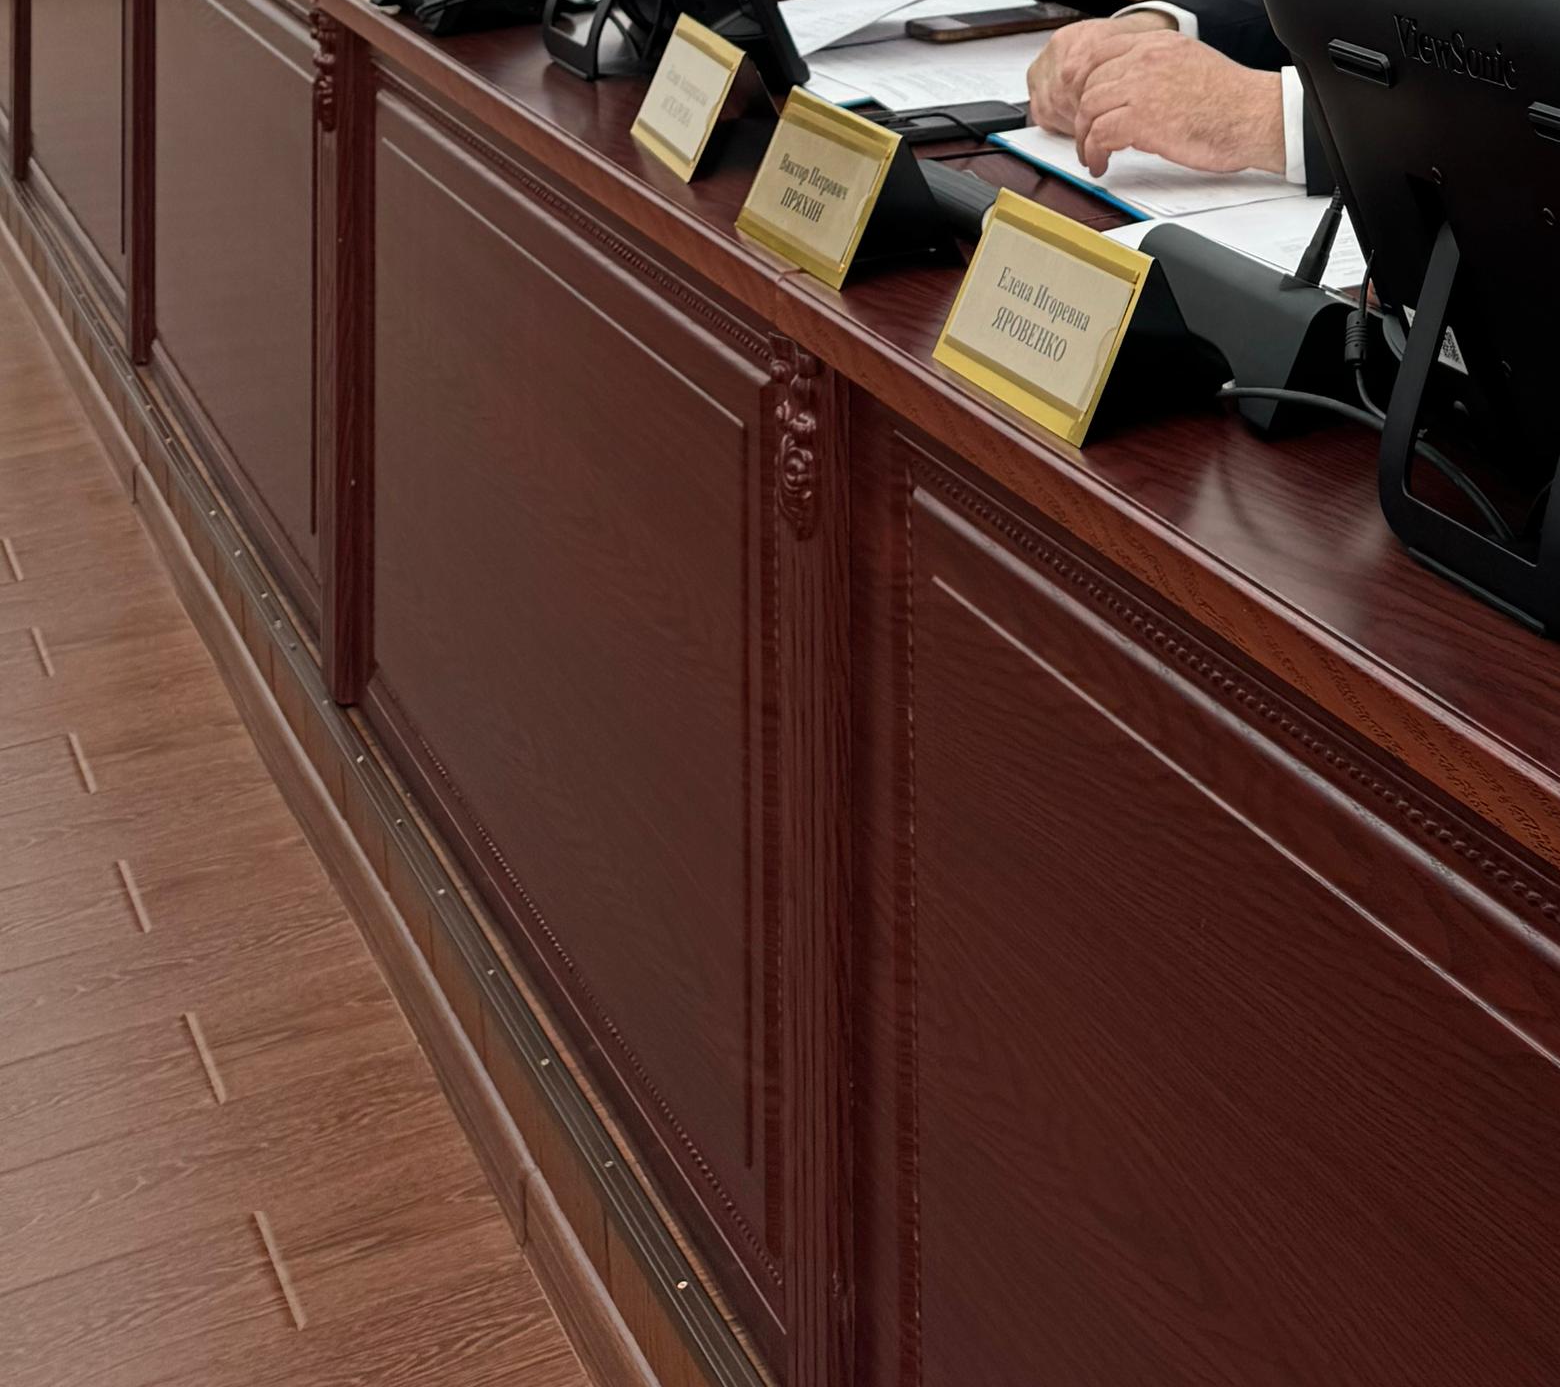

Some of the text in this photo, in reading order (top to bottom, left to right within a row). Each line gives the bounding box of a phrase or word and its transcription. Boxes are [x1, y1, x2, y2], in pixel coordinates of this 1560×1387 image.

[1392, 13, 1517, 91] ViewSonic
[779, 153, 849, 201] Виктор Петрович
[780, 186, 825, 223] ПРЯХИН
[997, 266, 1091, 332] Елена Игоревна
[991, 306, 1068, 362] ЯРОВЕНКО
